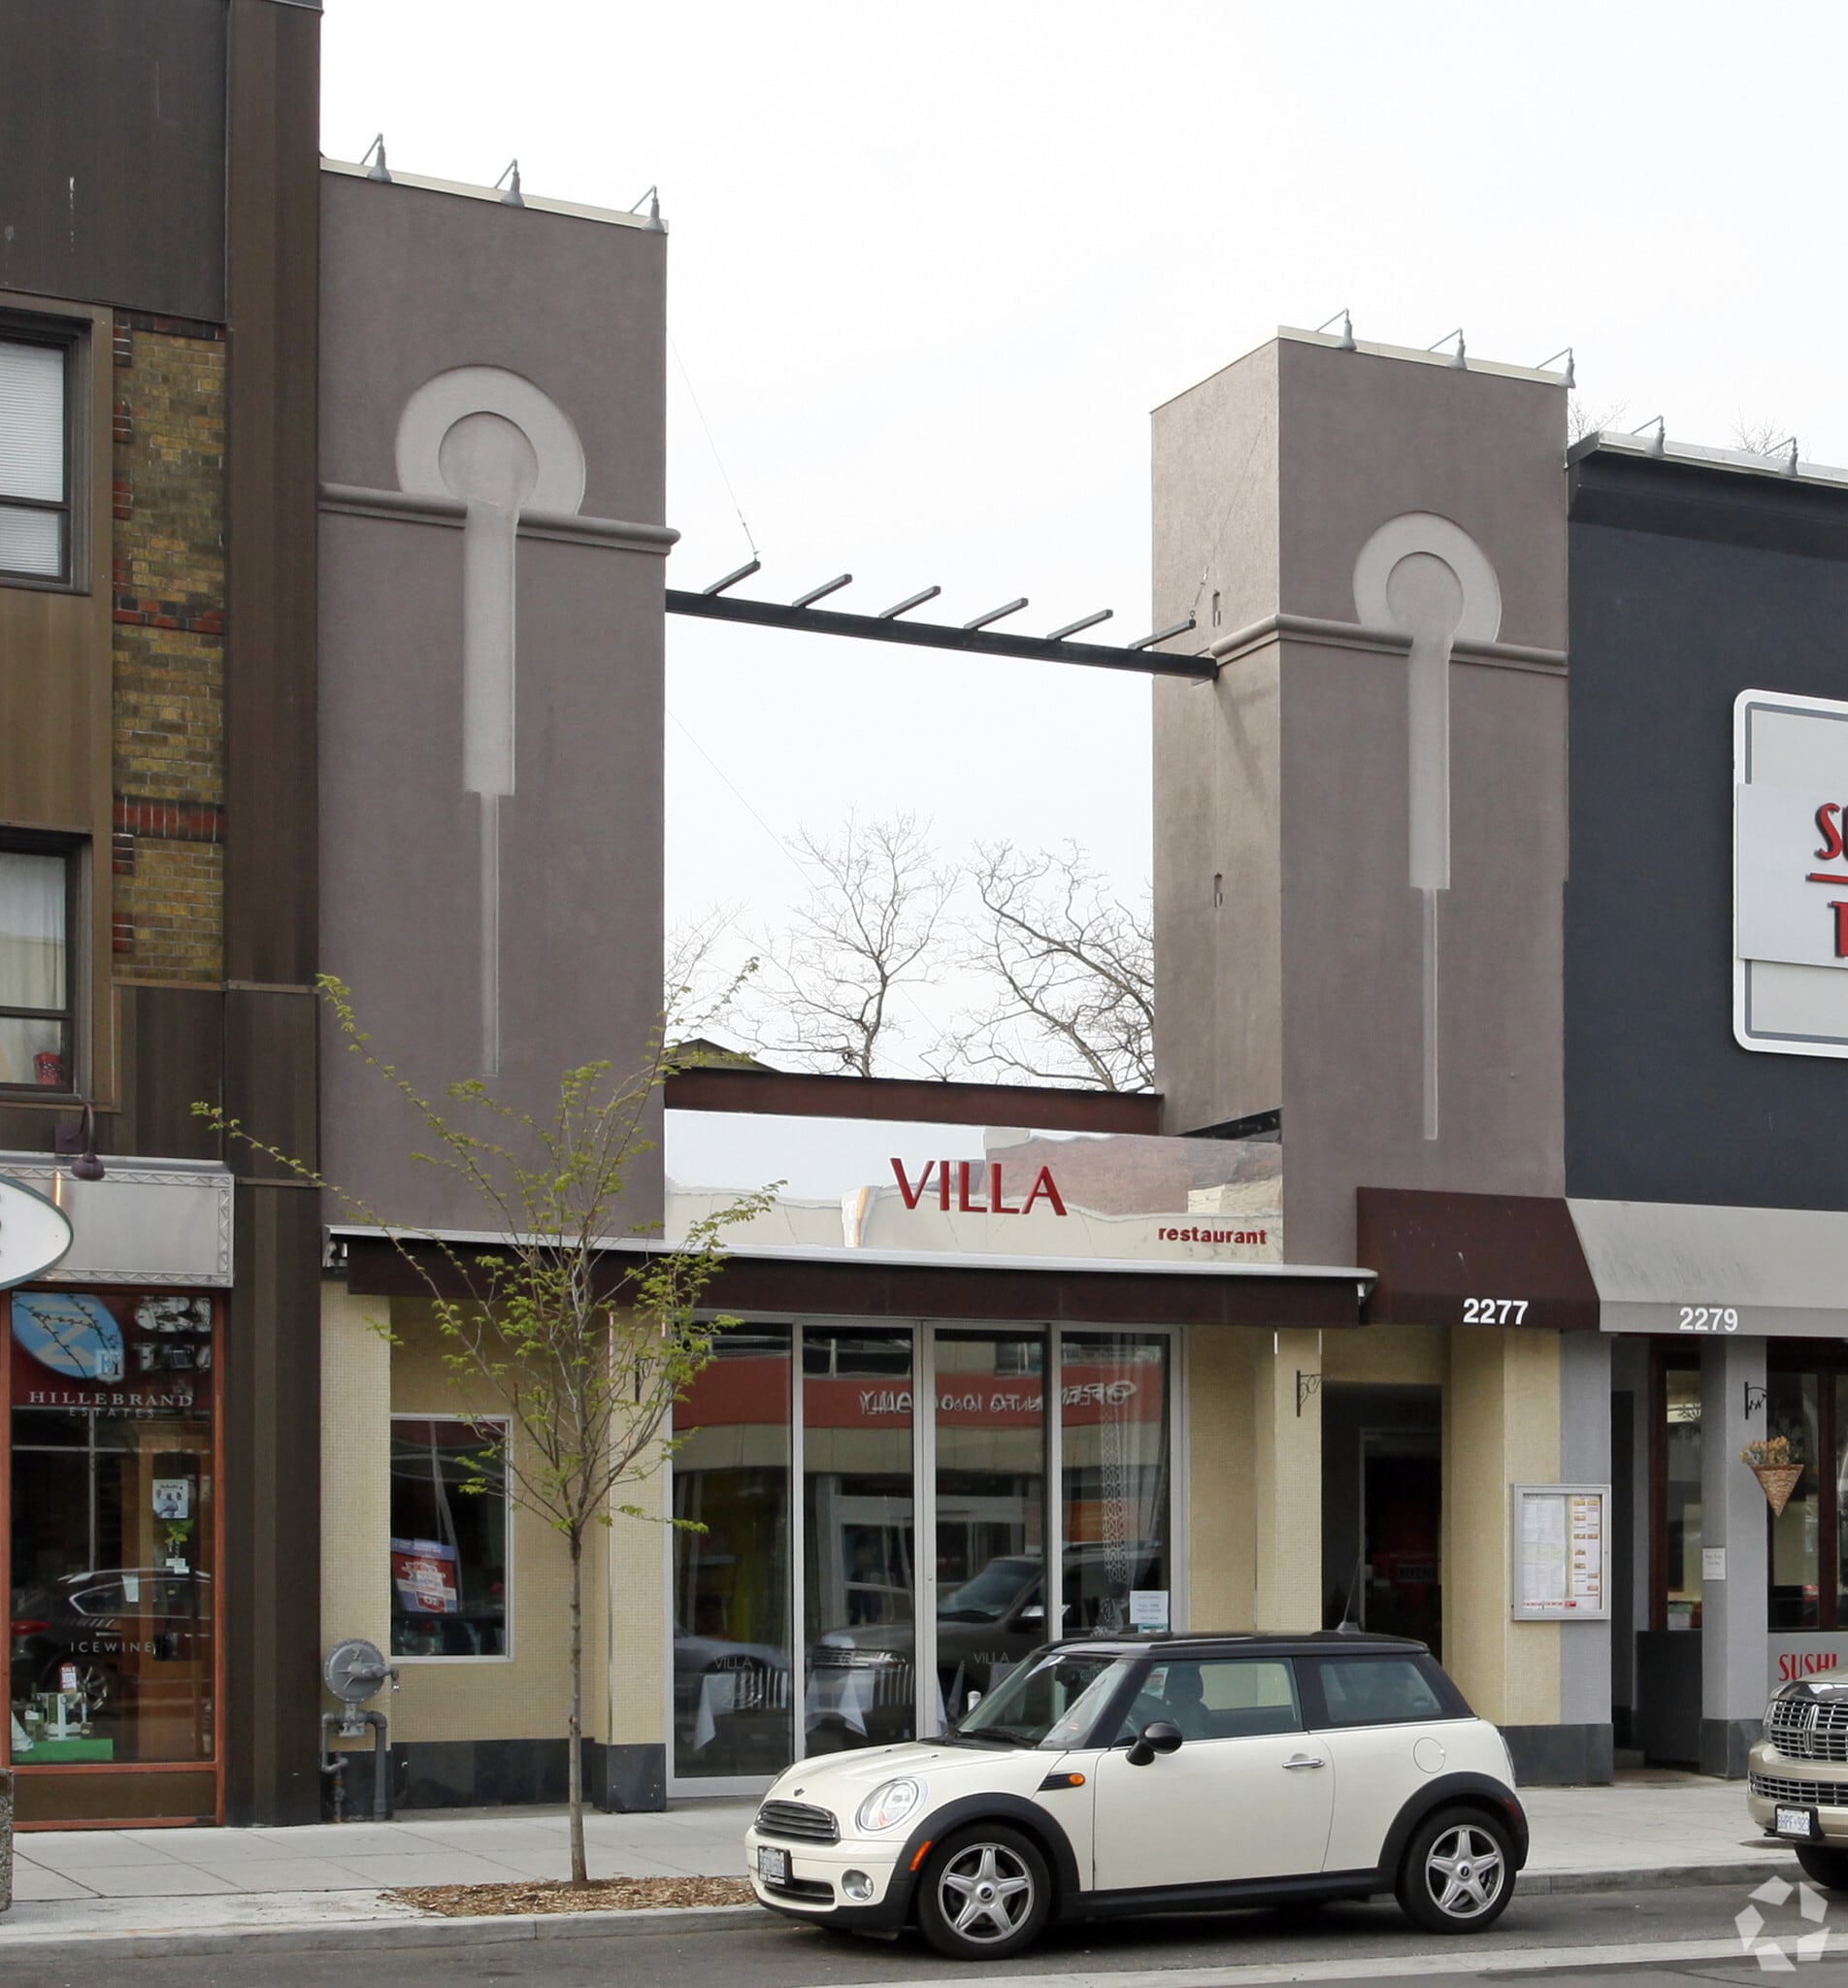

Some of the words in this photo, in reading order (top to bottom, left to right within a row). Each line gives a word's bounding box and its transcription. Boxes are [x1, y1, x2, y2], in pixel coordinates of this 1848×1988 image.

[890, 1158, 1067, 1216] VILLA
[1158, 1225, 1268, 1244] restaurant
[1463, 1298, 1529, 1325] 2277
[1679, 1307, 1738, 1333] 2279
[29, 1391, 193, 1407] HILLEBRAND
[69, 1407, 154, 1419] ESTATES
[70, 1641, 152, 1652] ICEWINE
[714, 1655, 753, 1670] VILLA
[974, 1651, 1010, 1665] VILLA
[1778, 1653, 1837, 1681] SUSHI
